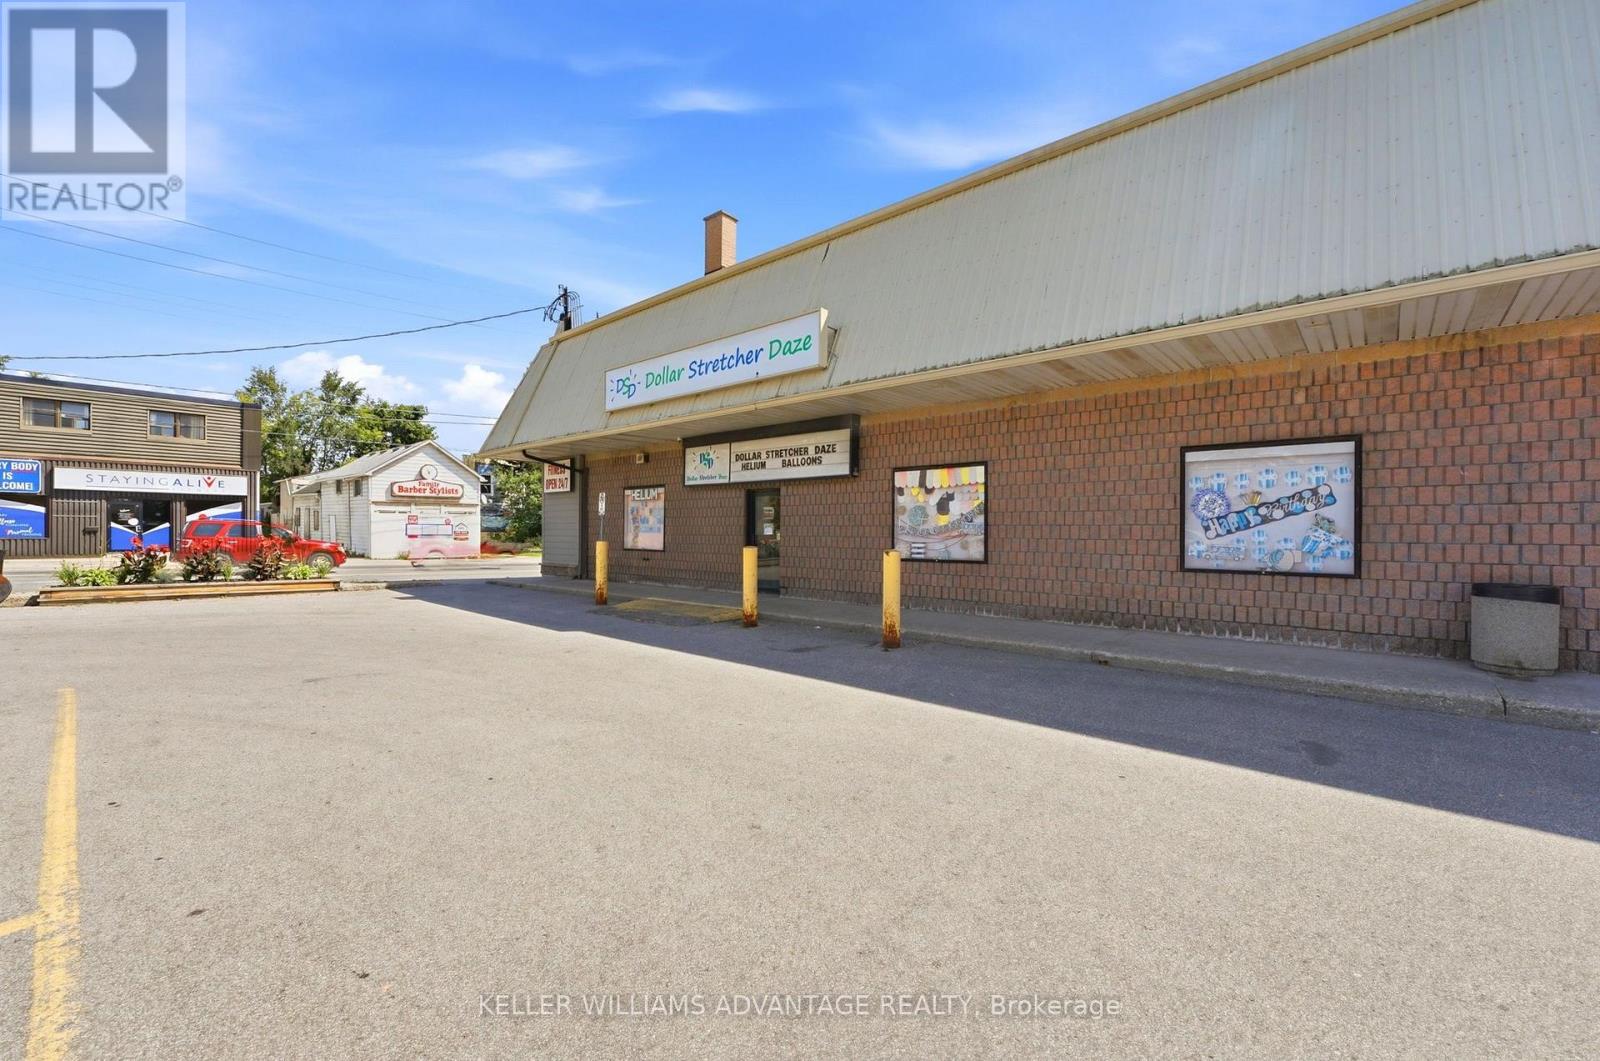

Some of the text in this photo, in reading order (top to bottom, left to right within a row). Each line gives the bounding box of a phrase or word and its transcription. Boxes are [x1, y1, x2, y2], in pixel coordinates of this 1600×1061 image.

[645, 365, 685, 389] Dollar
[688, 347, 764, 379] Stretcher
[768, 334, 812, 360] Daze
[735, 443, 837, 462] DOLLAR STRETCHER DAZE
[0, 461, 38, 471] Y BODY
[741, 455, 823, 471] HELIUM BALLOONS
[2, 471, 13, 480] IS
[397, 485, 459, 495] Barber Stylists
[631, 489, 658, 501] HELIUM
